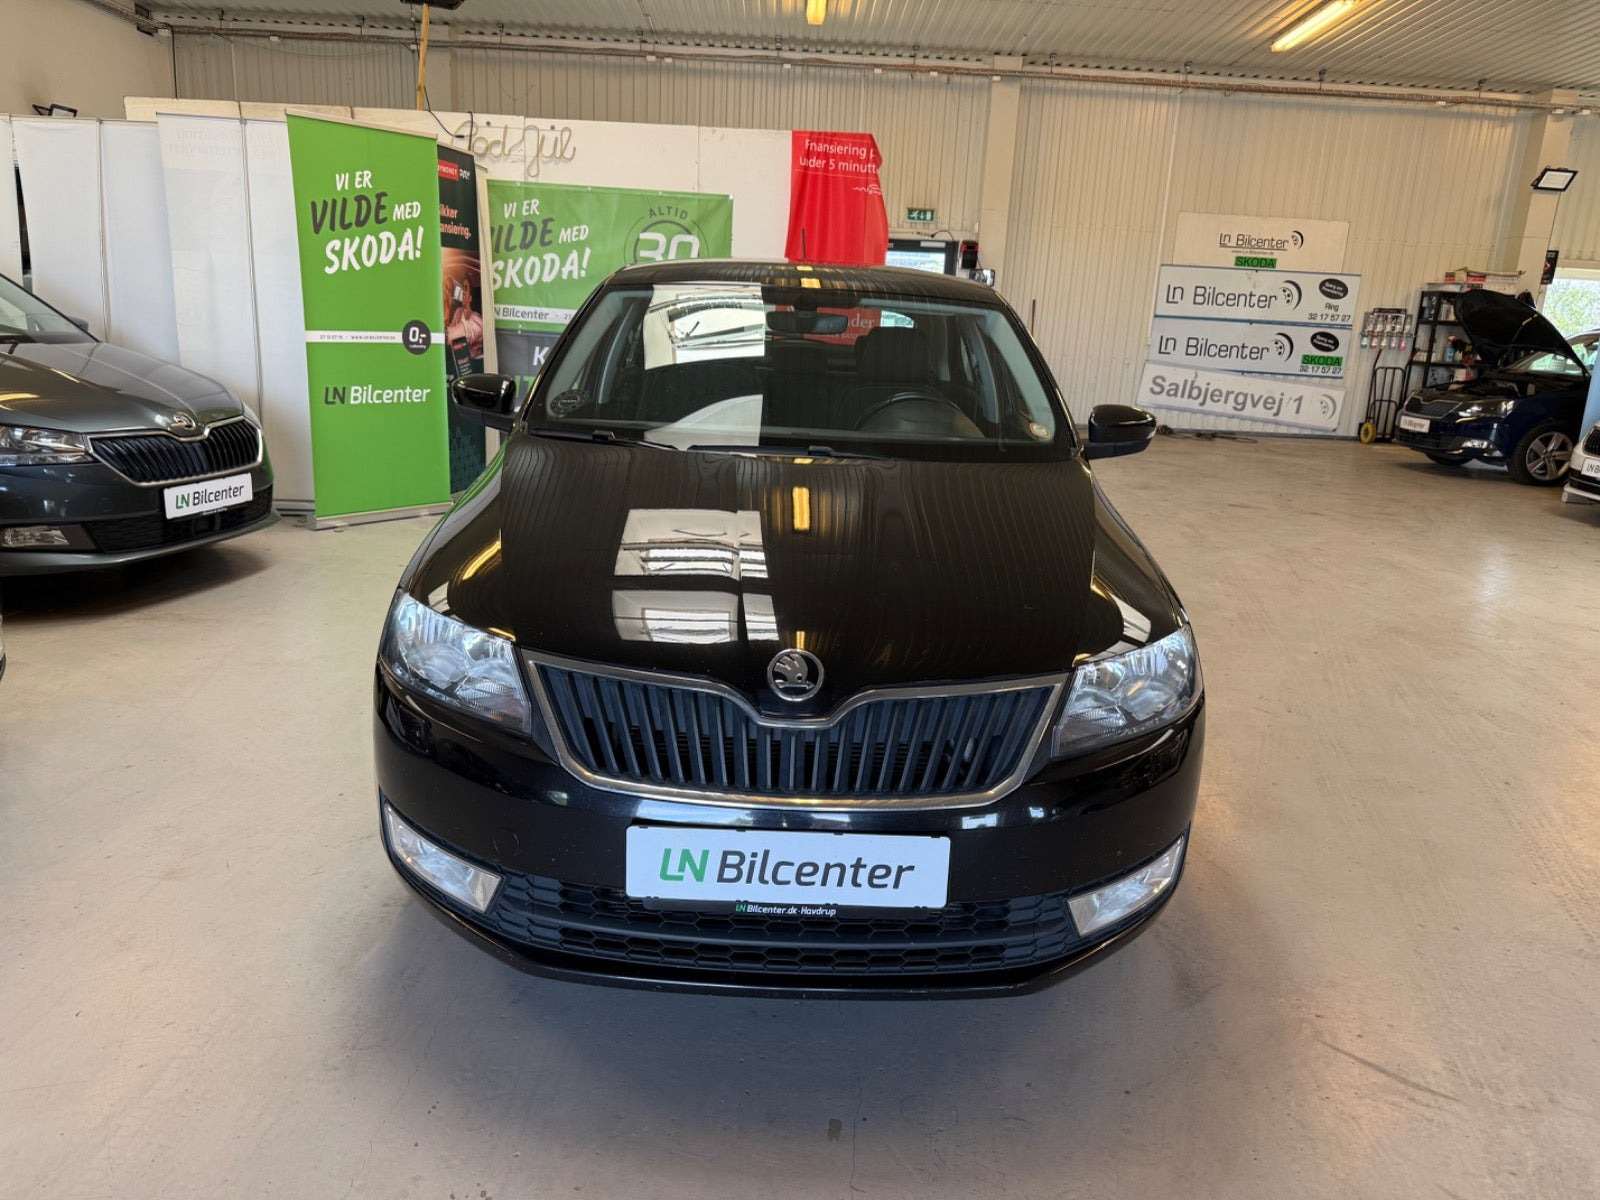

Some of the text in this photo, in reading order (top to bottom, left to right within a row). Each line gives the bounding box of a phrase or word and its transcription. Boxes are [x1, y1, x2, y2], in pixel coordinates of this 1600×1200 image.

[805, 139, 867, 160] Fnansiering
[828, 158, 836, 170] 5
[838, 160, 877, 174] minutt
[335, 170, 373, 191] VI ER
[310, 191, 421, 235] VILDE MED
[439, 204, 458, 218] ikker
[503, 199, 540, 219] VI ER
[649, 206, 688, 220] ALTID
[558, 225, 589, 244] MED
[1235, 234, 1290, 250] Bilcenter
[324, 225, 424, 275] SKODA!
[493, 247, 591, 291] SKODA!
[1235, 256, 1276, 269] SKODA
[1193, 286, 1278, 309] Bilcenter
[502, 307, 550, 320] Bilcenter
[848, 313, 875, 329] der
[1320, 313, 1329, 321] 17
[1185, 336, 1270, 360] Bilcenter
[1302, 354, 1343, 367] SKODA
[1311, 366, 1320, 374] 17
[324, 385, 431, 405] LN Bilcenter
[1150, 375, 1304, 417] Salbjergvej 1
[175, 485, 245, 510] LN Bilcenter
[659, 848, 916, 890] LN Bilcenter
[801, 906, 837, 917] Havdrup
